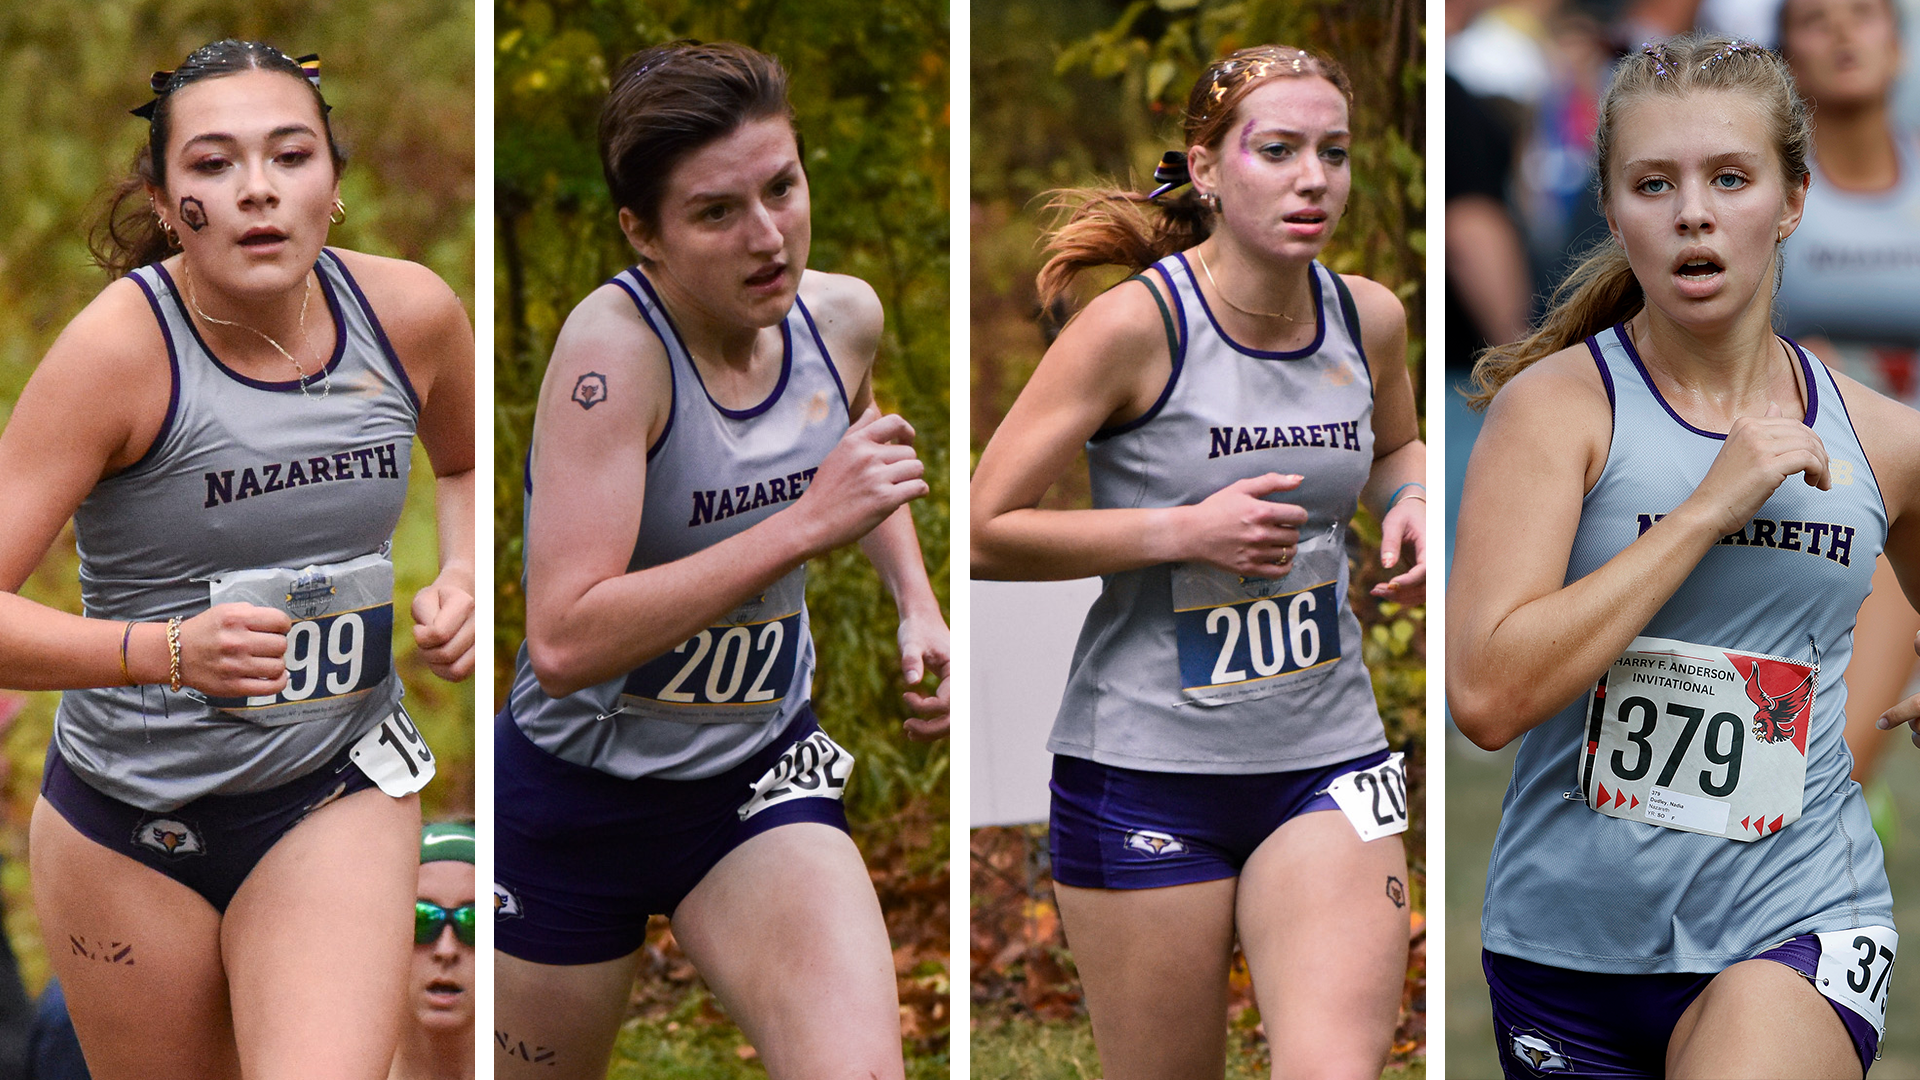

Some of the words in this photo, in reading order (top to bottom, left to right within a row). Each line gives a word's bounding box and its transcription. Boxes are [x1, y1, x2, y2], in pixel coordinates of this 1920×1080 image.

[1208, 420, 1361, 459] NAZARETH
[203, 443, 399, 509] NAZARETH
[688, 466, 819, 527] NAZARET
[246, 612, 365, 706] 99
[656, 620, 784, 702] 202
[1206, 591, 1320, 684] 206
[1614, 657, 1656, 669] HARRY
[1658, 660, 1667, 670] F.
[1669, 662, 1736, 682] ANDERSON
[1632, 672, 1716, 696] INVITATIONAL
[762, 731, 844, 801] 202
[1610, 696, 1744, 796] 379
[1354, 757, 1407, 826] 20
[1846, 935, 1895, 1016] 37
